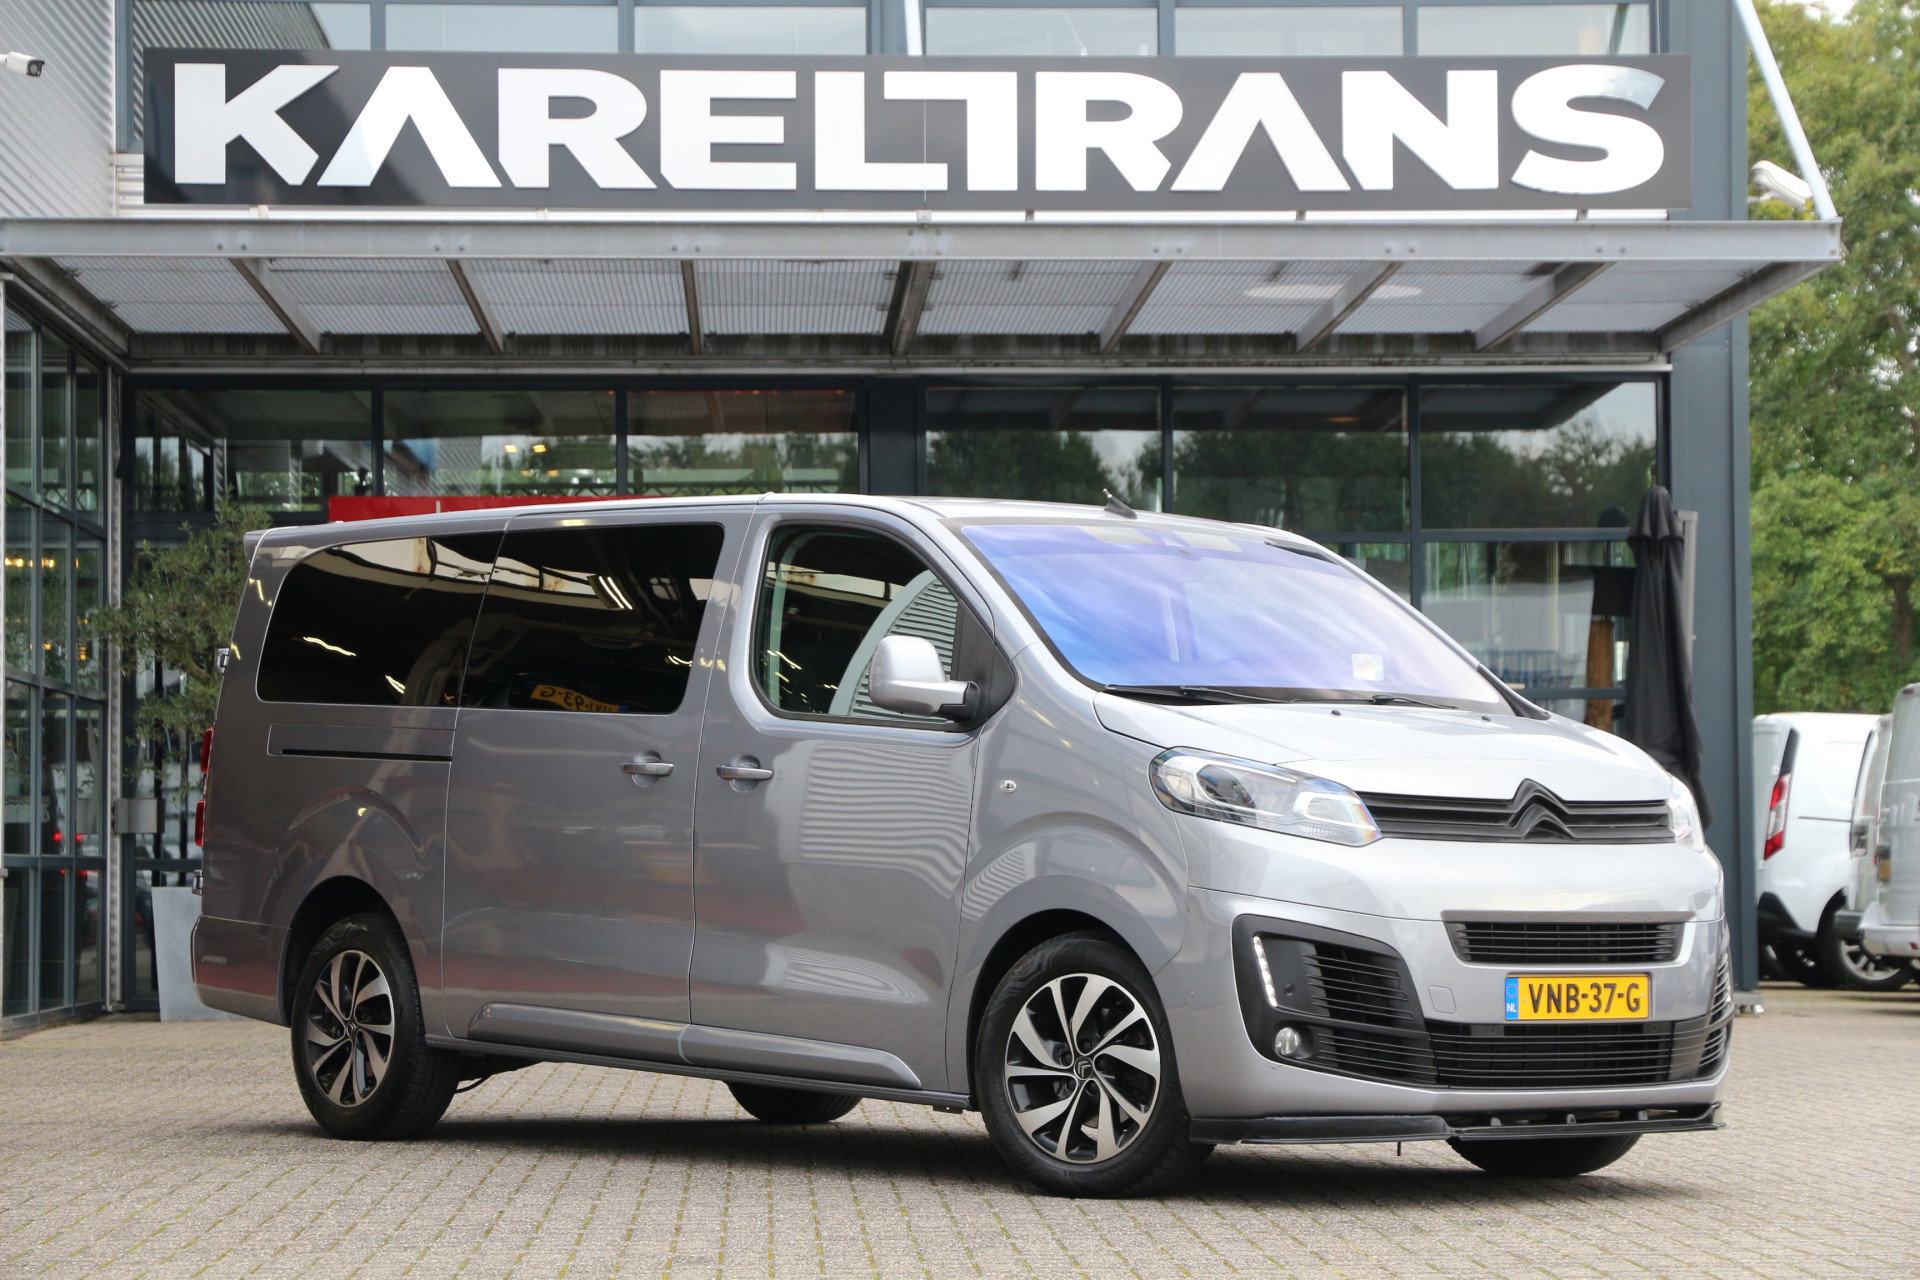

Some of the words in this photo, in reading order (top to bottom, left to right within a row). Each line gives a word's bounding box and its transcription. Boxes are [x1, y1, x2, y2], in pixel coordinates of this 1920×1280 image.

[174, 62, 1665, 195] KARELTRANS
[1506, 1003, 1518, 1013] NL
[1528, 982, 1641, 1014] VNB-37-G
